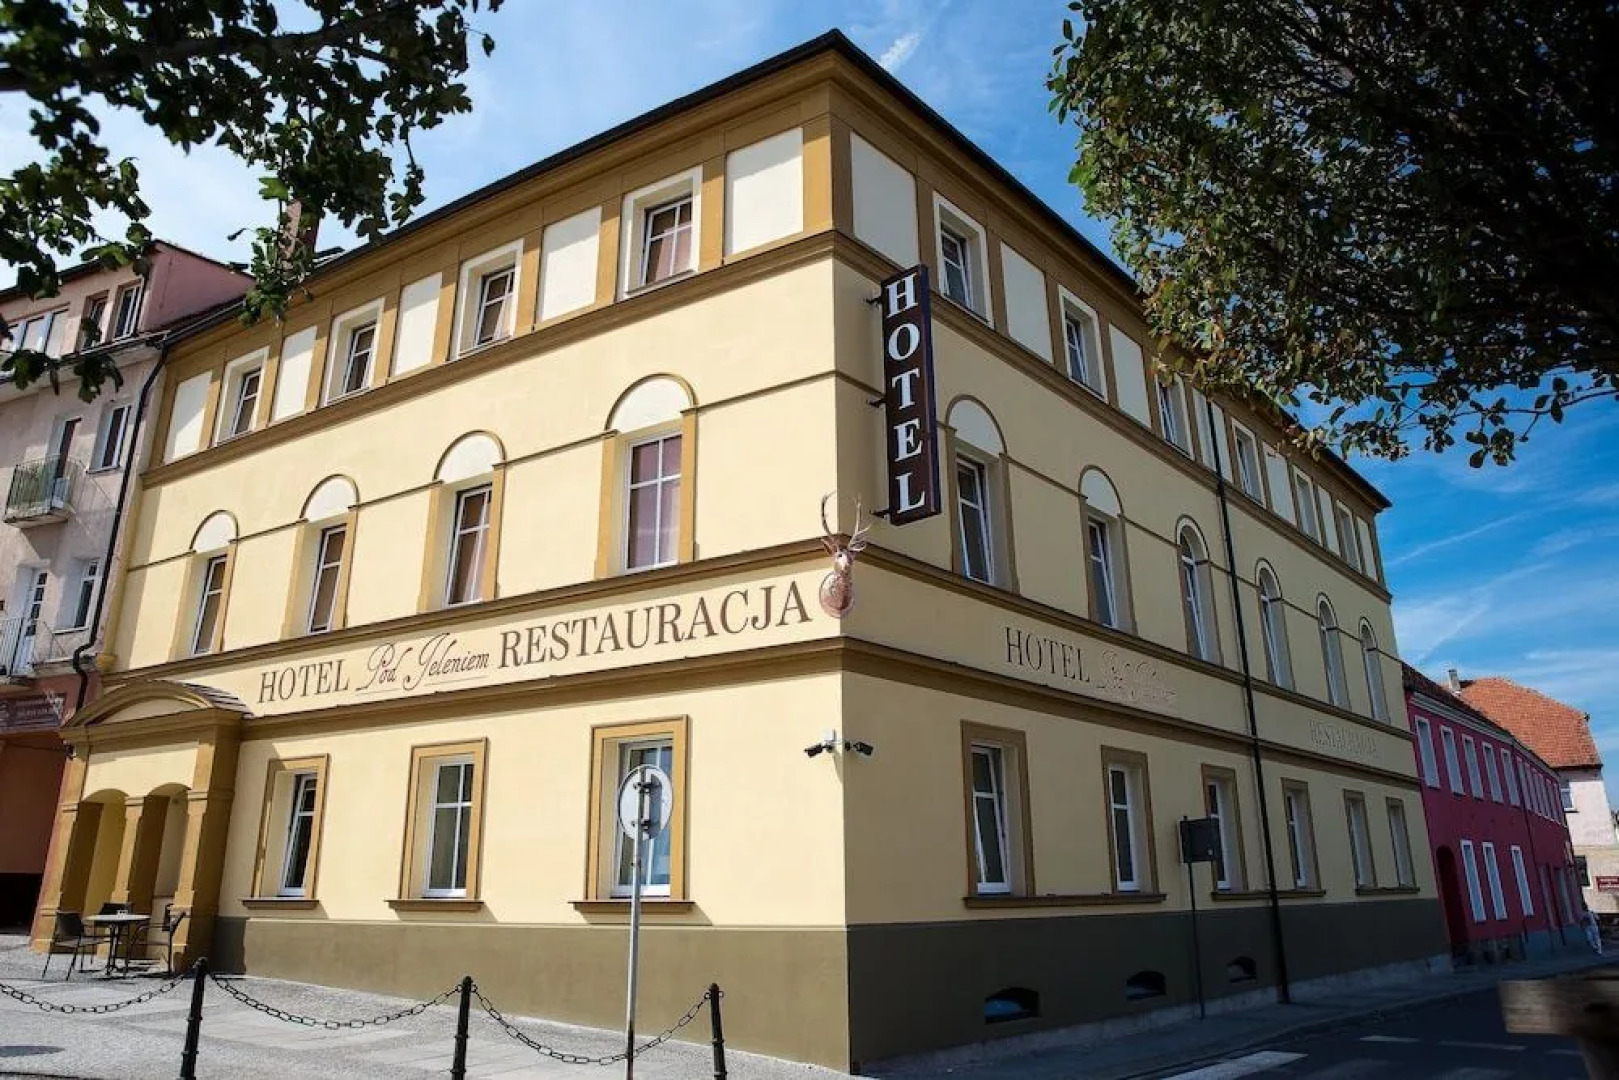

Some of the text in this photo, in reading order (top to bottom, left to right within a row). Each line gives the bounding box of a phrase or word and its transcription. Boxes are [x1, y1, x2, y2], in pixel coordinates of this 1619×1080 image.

[886, 273, 926, 514] HOTEL
[259, 580, 813, 703] HOTEL Pod Jeleniem RESTAURACJA
[1005, 626, 1090, 683] HOTEL
